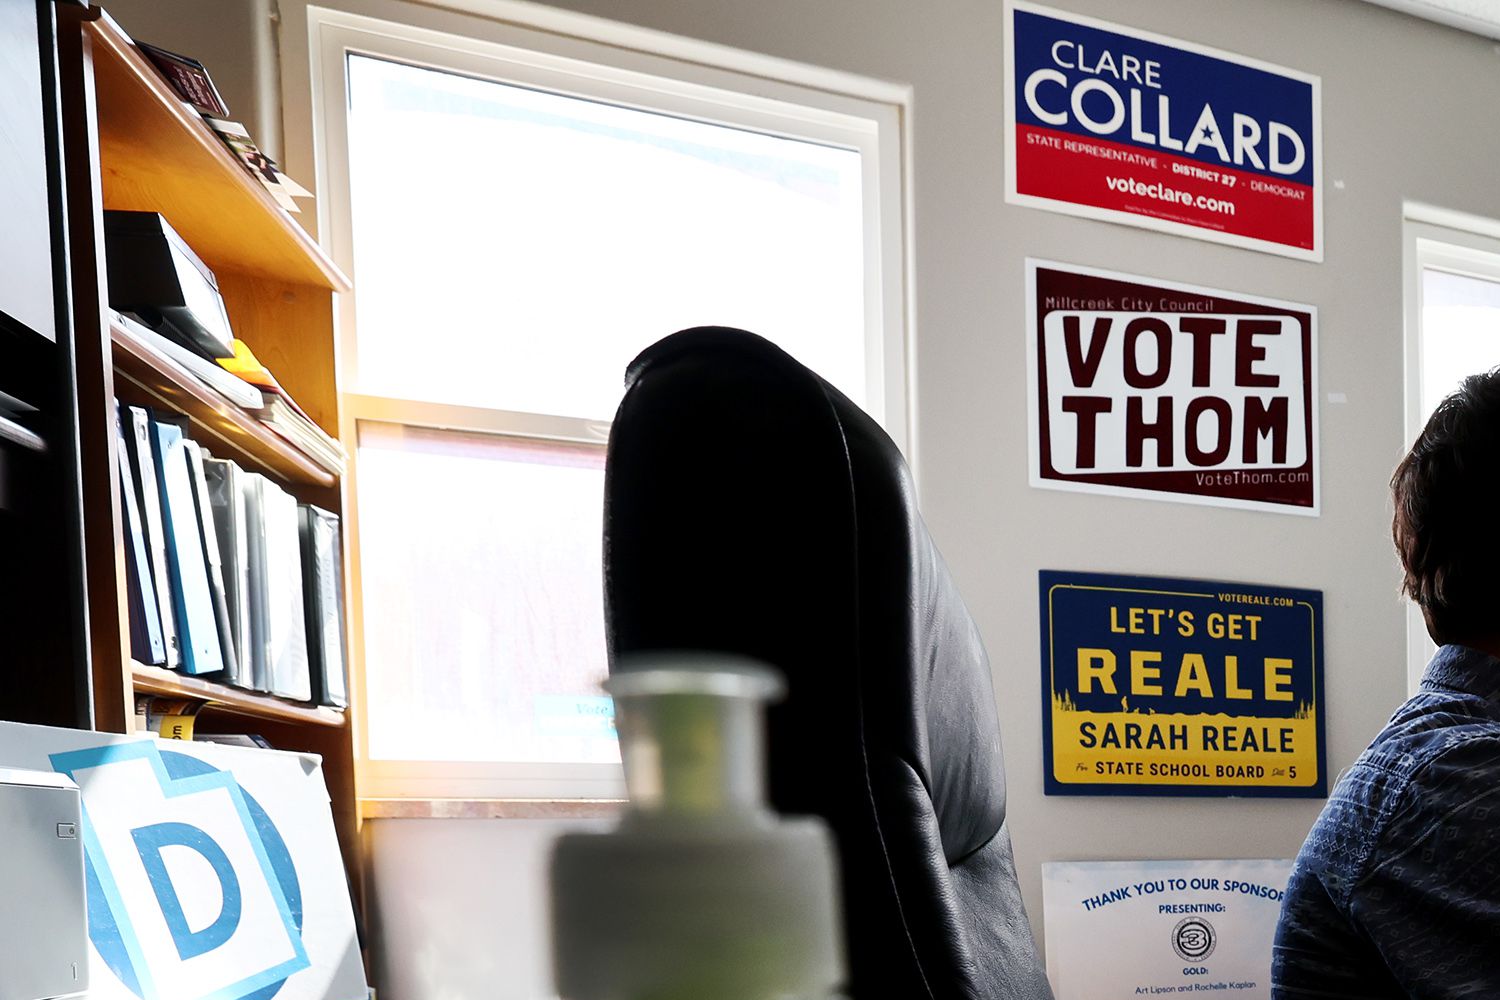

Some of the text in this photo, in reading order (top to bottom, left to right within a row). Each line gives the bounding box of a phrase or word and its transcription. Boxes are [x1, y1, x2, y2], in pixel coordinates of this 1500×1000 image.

[1051, 40, 1162, 89] CLARE
[1023, 68, 1306, 175] COLLARD
[1026, 133, 1306, 201] STATE REPRESENTATIVE DISTRICT 27 DEMOCRAT
[1105, 174, 1236, 216] voteclare.com
[1045, 296, 1214, 313] Millcreek City Council
[1062, 315, 1282, 389] VOTE
[1061, 395, 1289, 469] THOM
[1195, 470, 1309, 486] VoteThom.com
[1217, 593, 1294, 607] VOTEREALE.COM
[1110, 606, 1262, 641] LET'S GET
[1077, 647, 1294, 701] REALE
[1079, 721, 1294, 753] SARAH REALE
[1095, 761, 1144, 775] STATE
[1149, 763, 1210, 777] SCHOOL
[1215, 764, 1264, 778] BOARD
[1288, 766, 1297, 779] 5
[130, 822, 242, 961] D
[1081, 886, 1132, 912] THANK
[1133, 880, 1165, 896] YOU
[1167, 878, 1187, 891] TO
[1190, 878, 1219, 890] OUR
[1158, 903, 1226, 914] PRESENTING:
[1135, 980, 1257, 996] Art Lipson and Rochelle Kaplan
[1182, 967, 1209, 976] GOLD:
